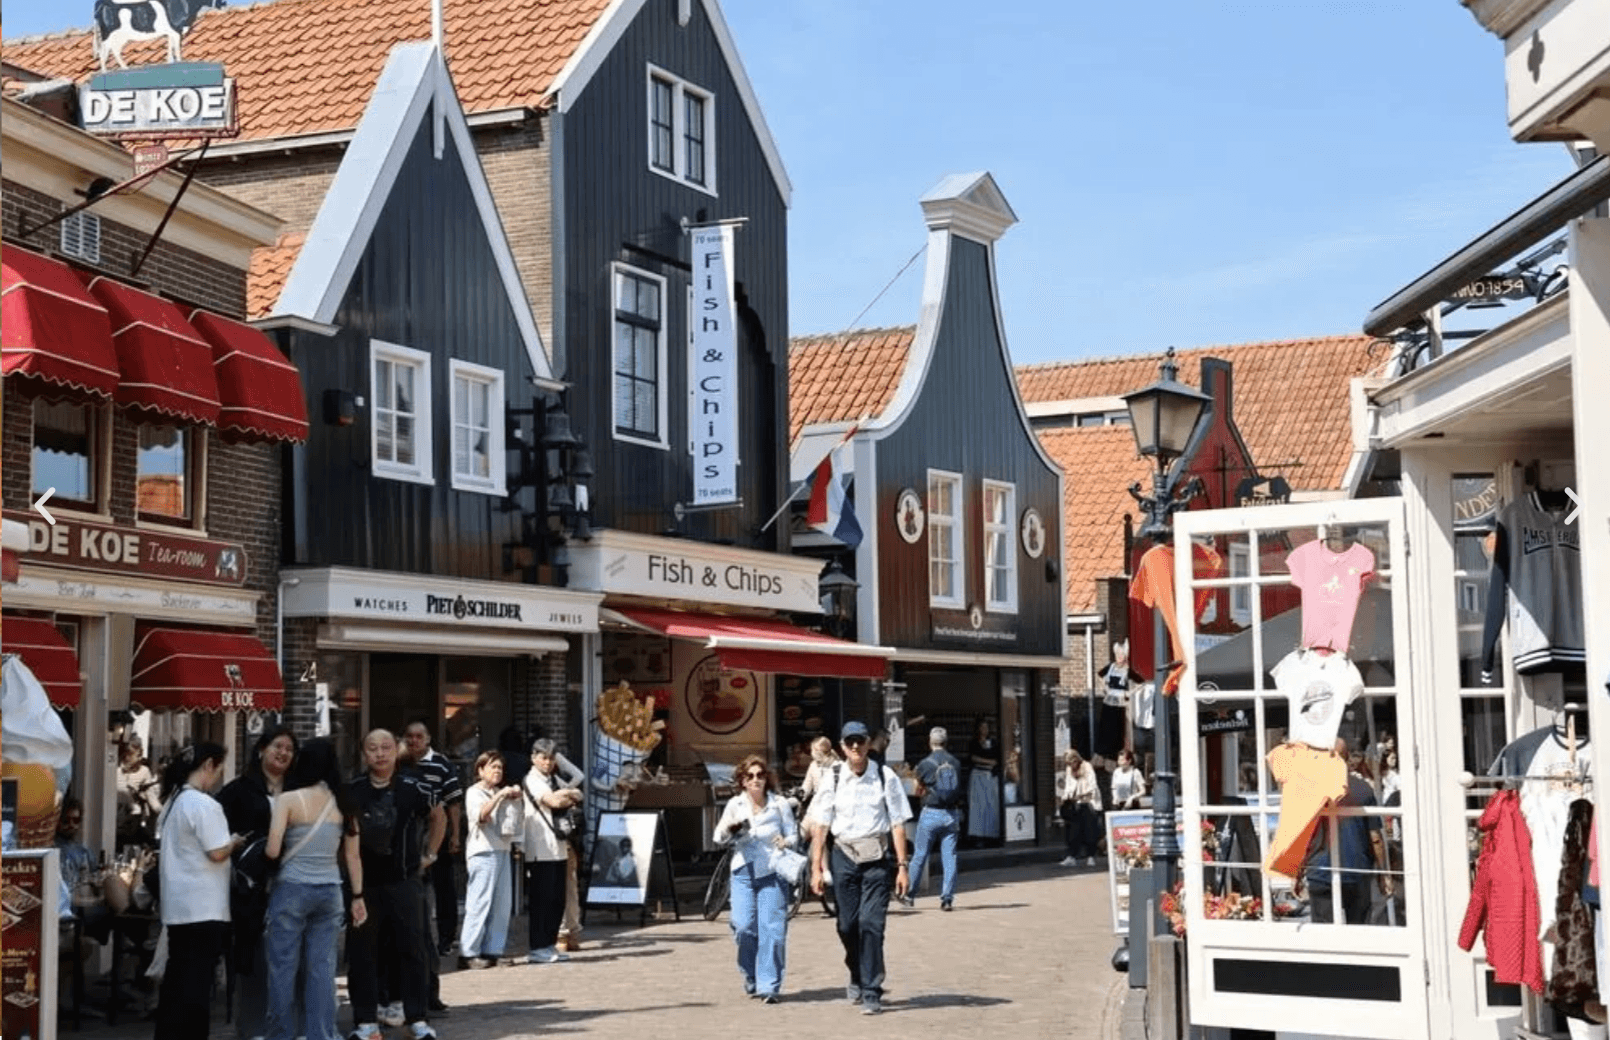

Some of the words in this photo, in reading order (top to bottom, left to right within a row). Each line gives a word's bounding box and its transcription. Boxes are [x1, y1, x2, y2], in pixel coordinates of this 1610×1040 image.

[84, 91, 136, 125] DE
[149, 87, 226, 123] KOE
[702, 252, 721, 332] Fish
[702, 348, 723, 363] &
[29, 521, 69, 556] DE
[81, 529, 140, 564] KOE
[147, 541, 207, 569] Tea-room
[648, 554, 693, 585] Fish
[702, 566, 717, 587] &
[724, 565, 783, 597] Chips
[354, 596, 408, 612] WATCHES
[426, 593, 453, 615] PIET
[466, 600, 522, 622] SCHILDER
[300, 661, 317, 682] 24
[221, 692, 233, 707] DE
[235, 692, 254, 707] KOE
